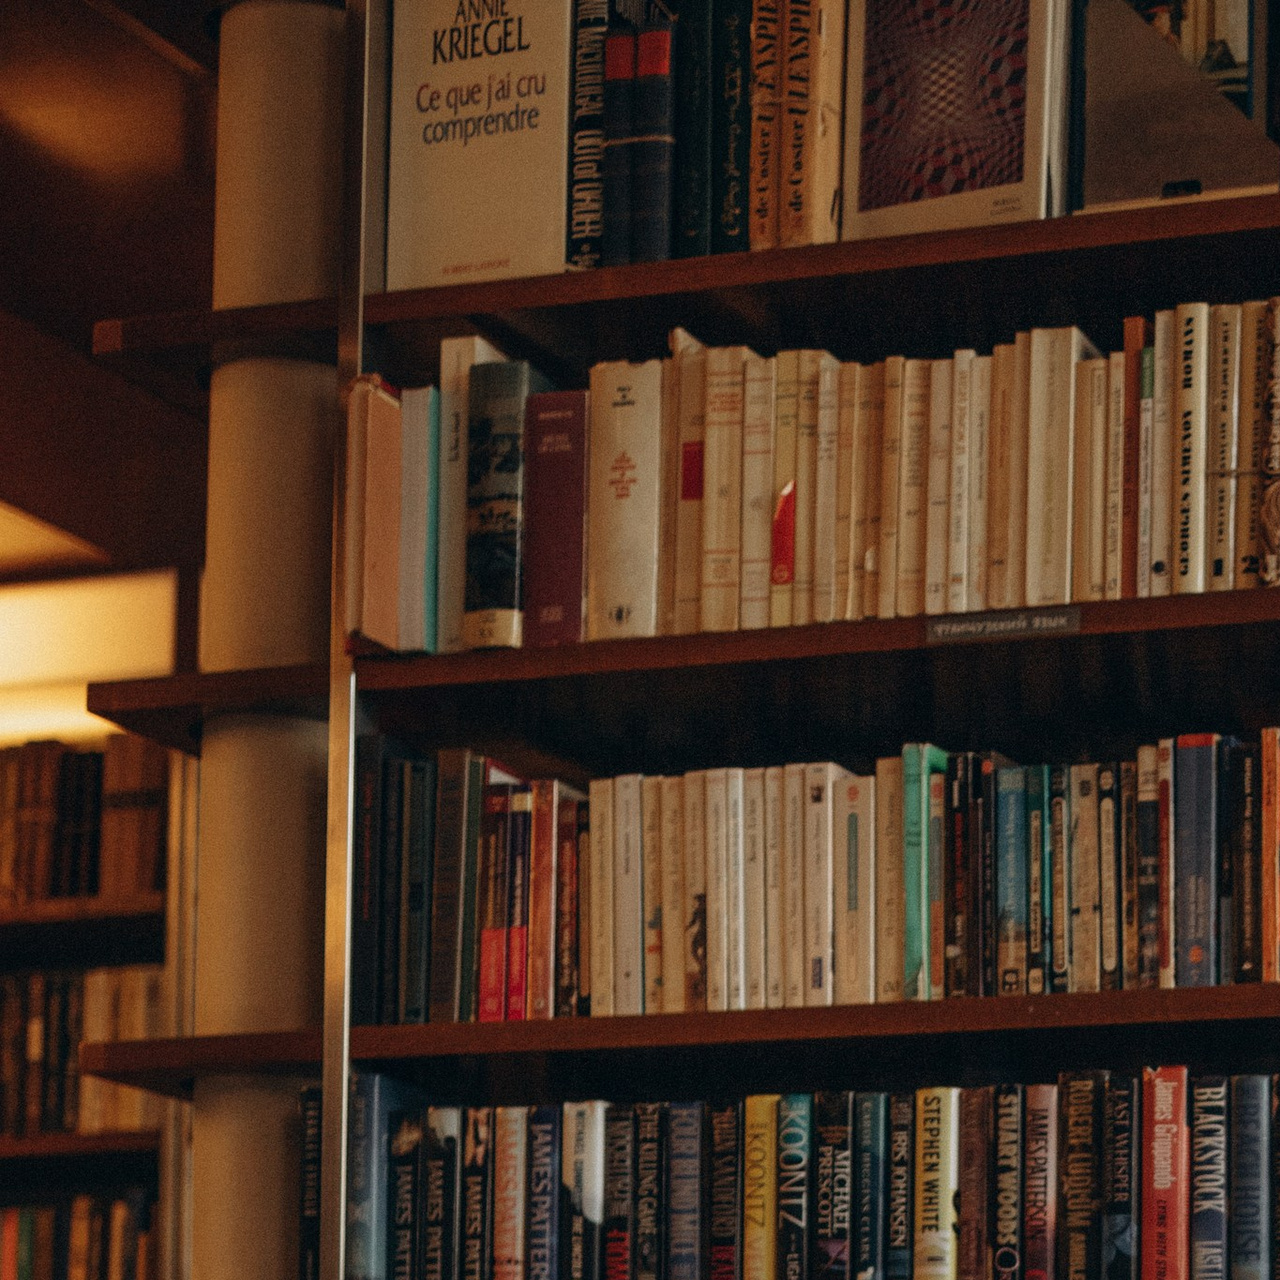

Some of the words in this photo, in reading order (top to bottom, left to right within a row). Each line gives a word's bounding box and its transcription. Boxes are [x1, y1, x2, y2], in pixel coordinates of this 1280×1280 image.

[432, 17, 530, 64] KRIEGEL
[455, 0, 510, 23] ANNIE
[416, 83, 441, 113] Ce
[446, 84, 482, 114] que
[487, 72, 511, 110] j'ai
[516, 73, 546, 98] cru
[421, 104, 540, 146] comprendre
[789, 119, 804, 186] Coster
[757, 196, 769, 219] de
[789, 188, 803, 212] de
[1182, 316, 1195, 390] ROMANS
[1180, 409, 1193, 486] SIMENON
[1179, 491, 1191, 576] GEORGES
[861, 1101, 871, 1146] CAROL
[1067, 1080, 1093, 1144] ROBERT
[1114, 1089, 1129, 1128] LAST
[1153, 1079, 1176, 1120] James
[530, 1123, 553, 1193] JAMES
[671, 1108, 699, 1154] FOUR
[890, 1131, 906, 1161] IRIS
[922, 1096, 940, 1173] STEPHEN
[997, 1094, 1017, 1168] STUART
[1027, 1108, 1048, 1155] JAMES
[1150, 1123, 1177, 1189] Grippando
[1194, 1087, 1227, 1214] BLACKSTOCK
[1235, 1102, 1261, 1177] BEACH
[395, 1164, 412, 1224] JAMES
[427, 1159, 443, 1221] JAMES
[638, 1143, 658, 1196] KILLING
[745, 1132, 766, 1228] KOONTZ
[779, 1109, 807, 1229] KOONTZ
[817, 1145, 832, 1237] PRESCOTT
[833, 1150, 849, 1233] MICHAEL
[861, 1152, 871, 1213] HIGGINS
[1066, 1153, 1092, 1227] LUDLUM
[1114, 1131, 1129, 1202] WHISPER
[464, 1176, 481, 1235] JAMES
[889, 1164, 905, 1247] JOHANSEN
[921, 1180, 940, 1233] WHITE
[997, 1171, 1017, 1245] WOODS
[1027, 1157, 1048, 1242] PATTERSON
[1156, 1199, 1167, 1227] LYING
[1235, 1186, 1260, 1263] HOUSE
[671, 1214, 699, 1256] MICE
[860, 1216, 871, 1262] CLARK
[1156, 1231, 1167, 1255] WITH
[1195, 1240, 1222, 1272] LAST
